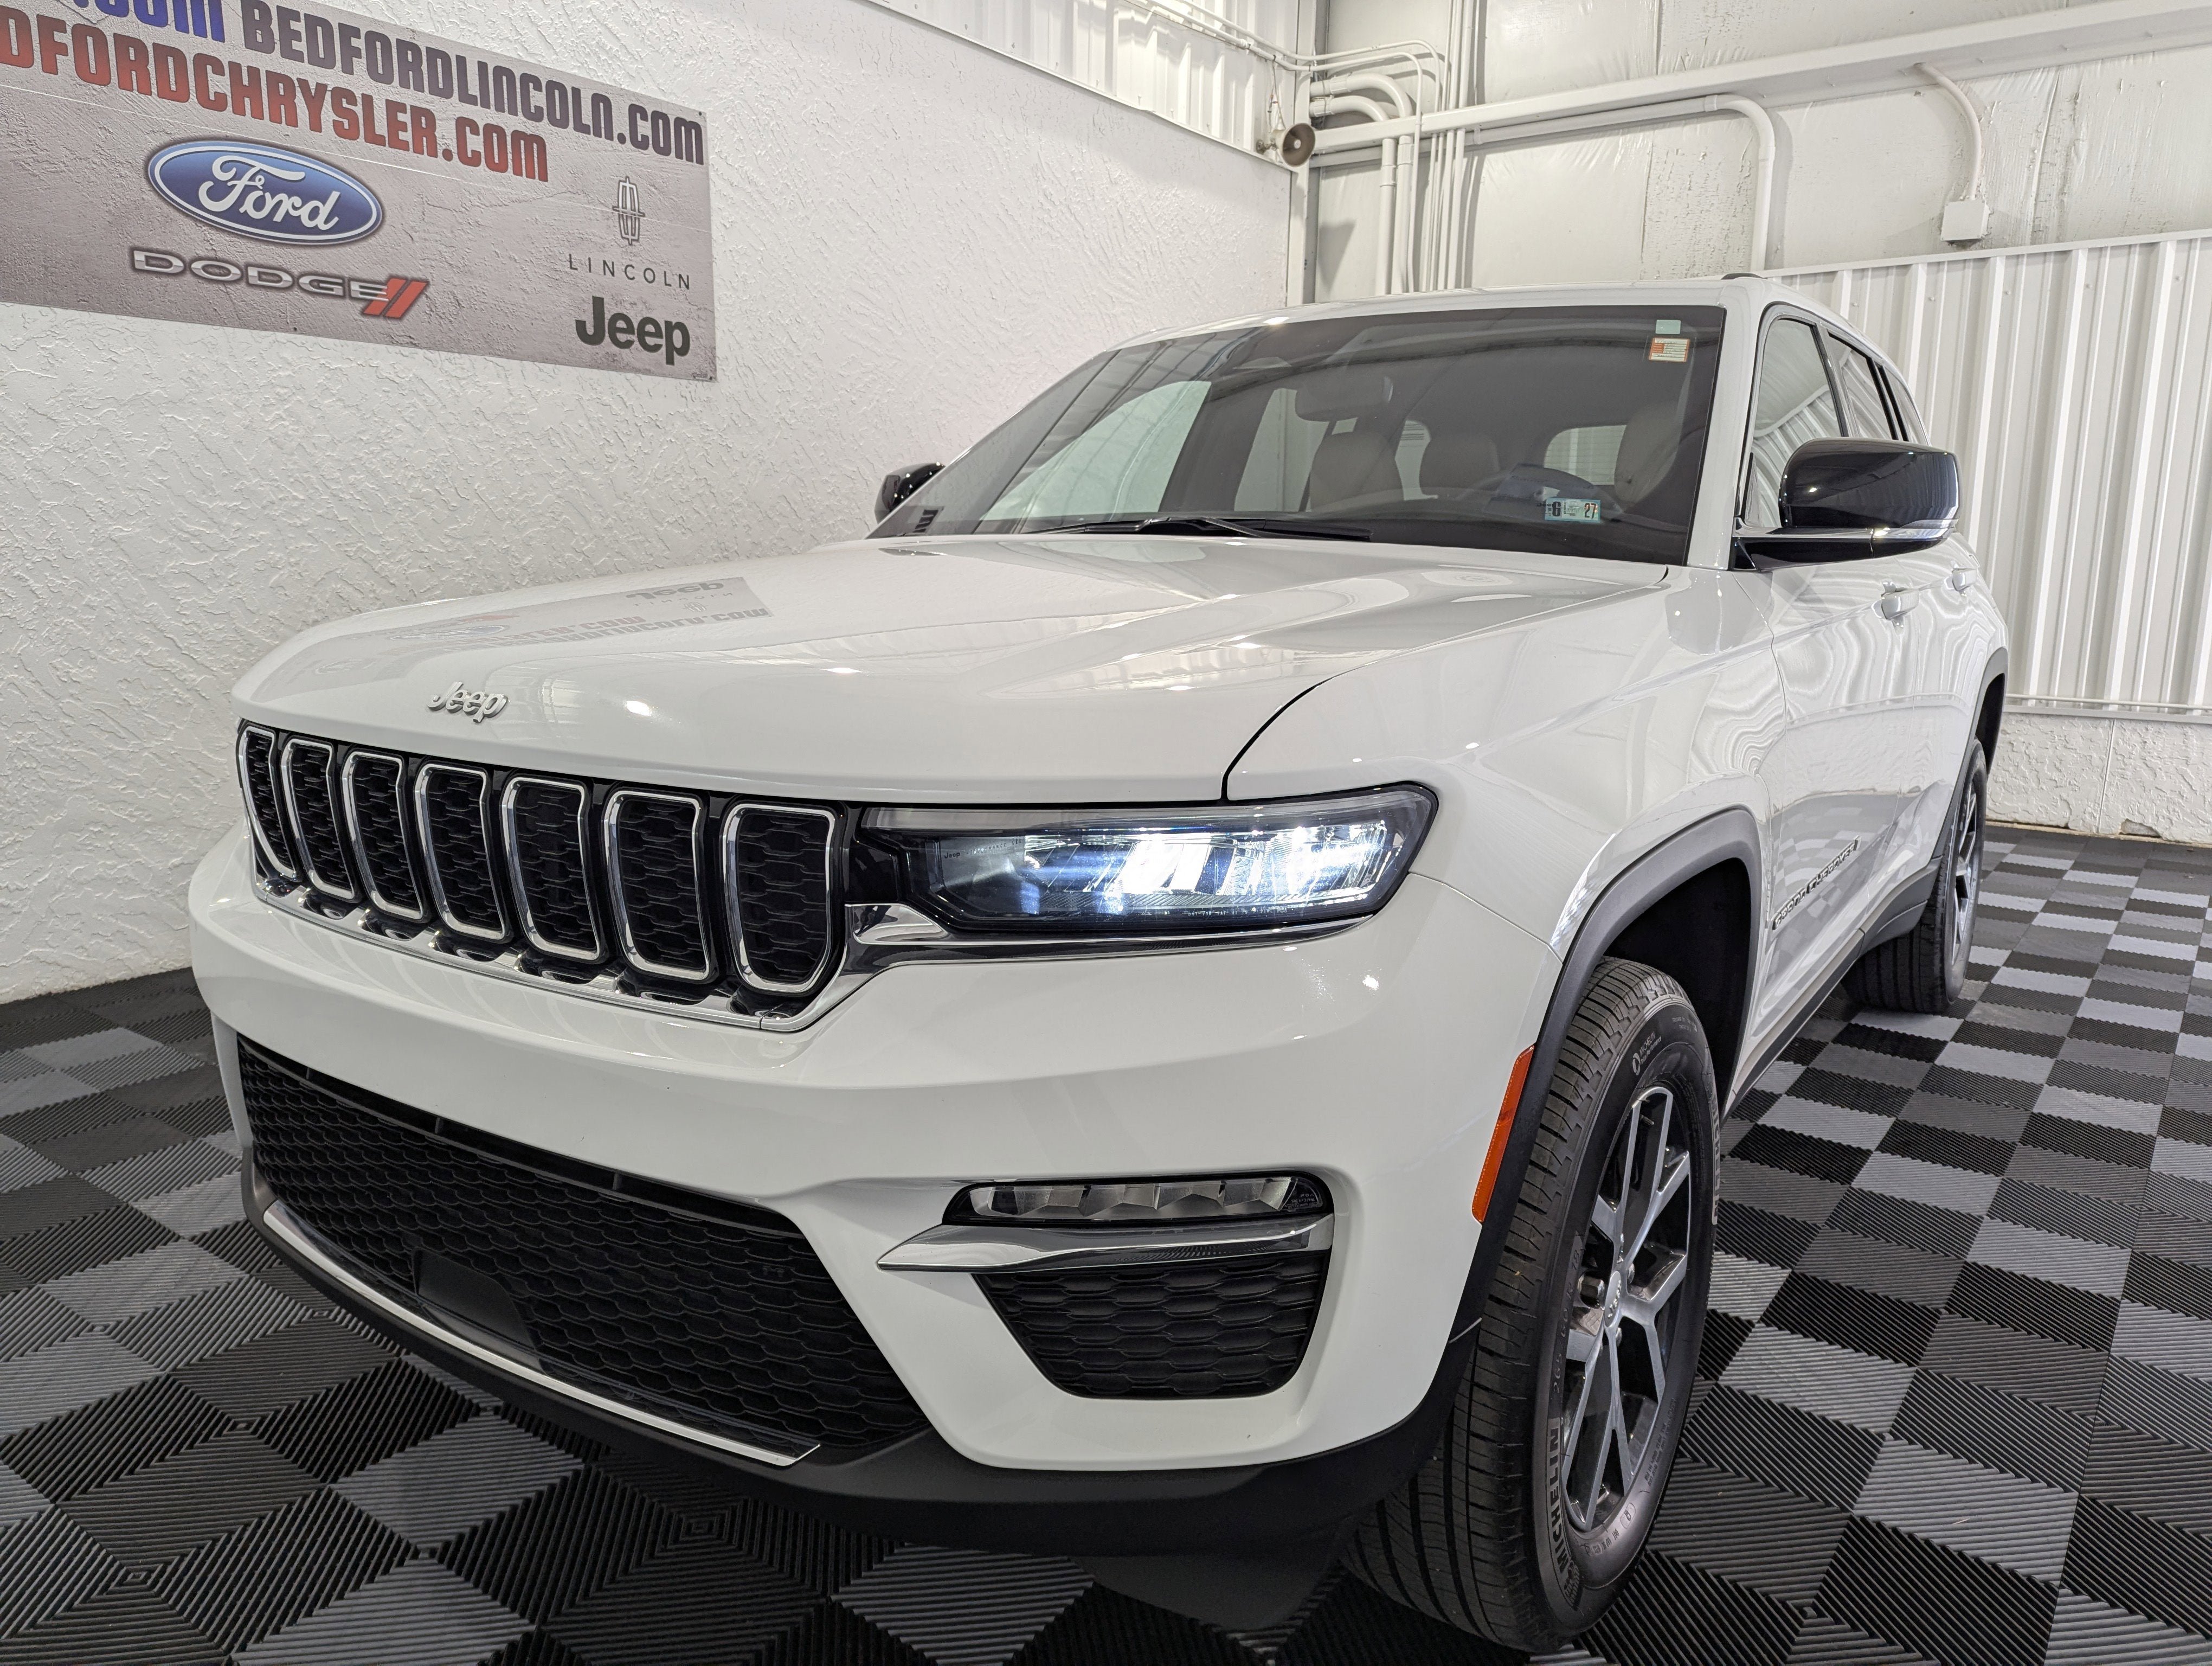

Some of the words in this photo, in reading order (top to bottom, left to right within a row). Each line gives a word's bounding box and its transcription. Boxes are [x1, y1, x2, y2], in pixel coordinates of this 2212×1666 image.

[241, 0, 704, 165] BEDFORDLINCOLN.COM
[198, 155, 340, 230] Ford
[133, 250, 389, 303] DODGE
[569, 253, 690, 290] LINCOLN
[575, 296, 691, 366] Jeep
[1584, 503, 1597, 519] 27
[427, 681, 509, 723] Jeep
[1549, 1427, 1568, 1573] MICHELIN
